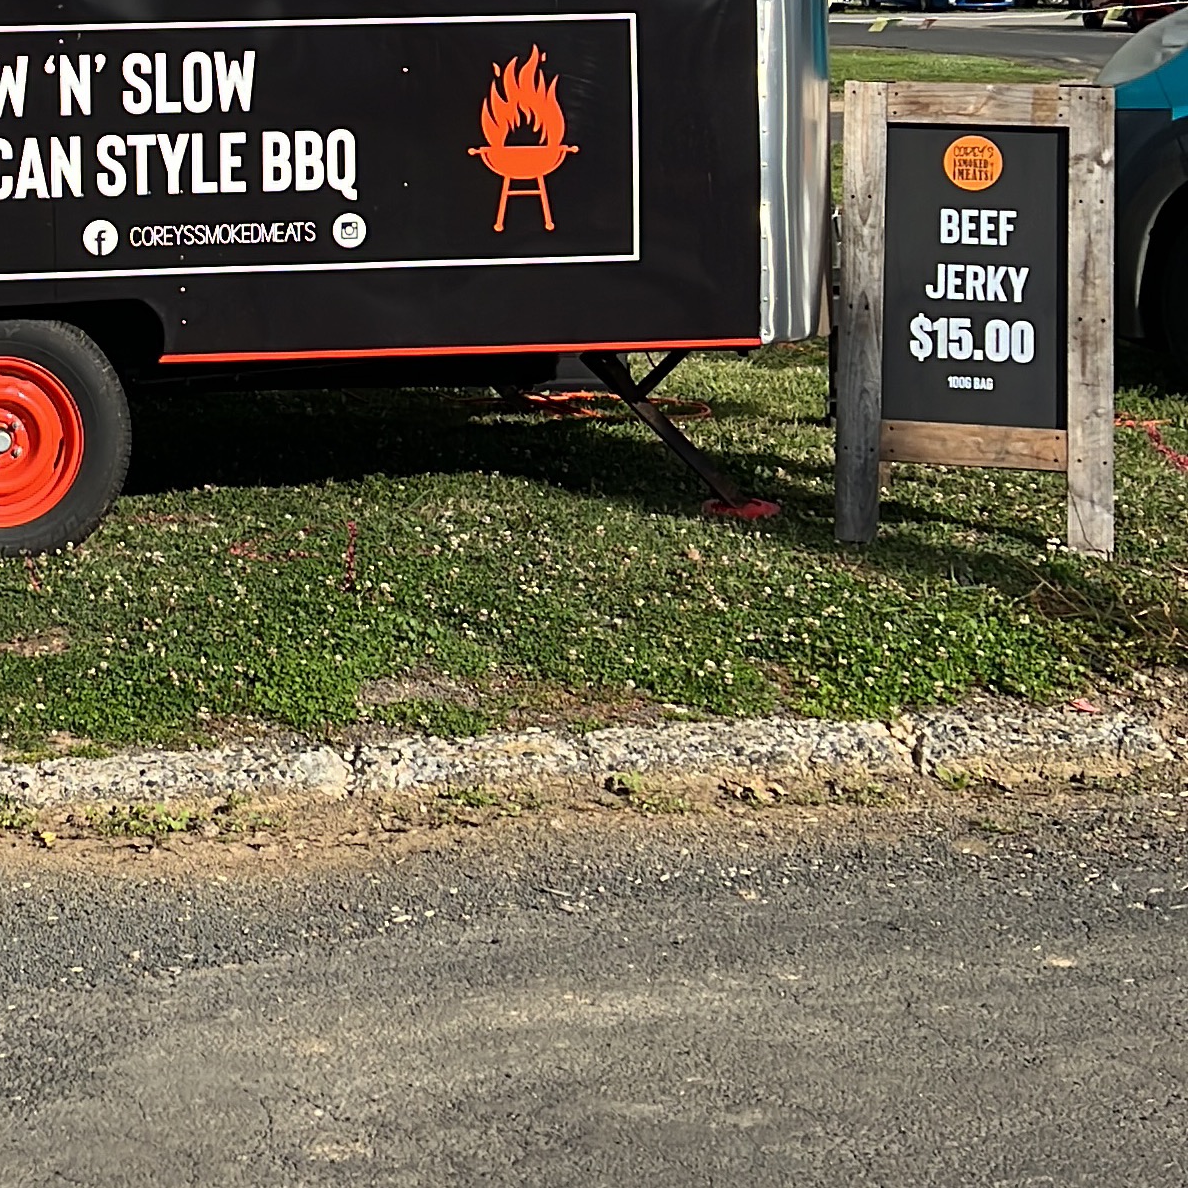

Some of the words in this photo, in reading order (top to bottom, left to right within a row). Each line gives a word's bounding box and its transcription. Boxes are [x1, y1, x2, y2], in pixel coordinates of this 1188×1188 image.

[122, 50, 256, 115] SLOW
[96, 132, 247, 198] STYLE
[262, 128, 358, 201] BBQ
[956, 168, 989, 181] MEATS
[957, 158, 990, 168] SMOKED
[129, 222, 317, 248] COREYSSMOKEDMEATS
[940, 208, 1017, 246] BEEF
[925, 263, 1030, 303] JERKY
[909, 313, 1035, 363] $15.00
[973, 376, 994, 391] BAG
